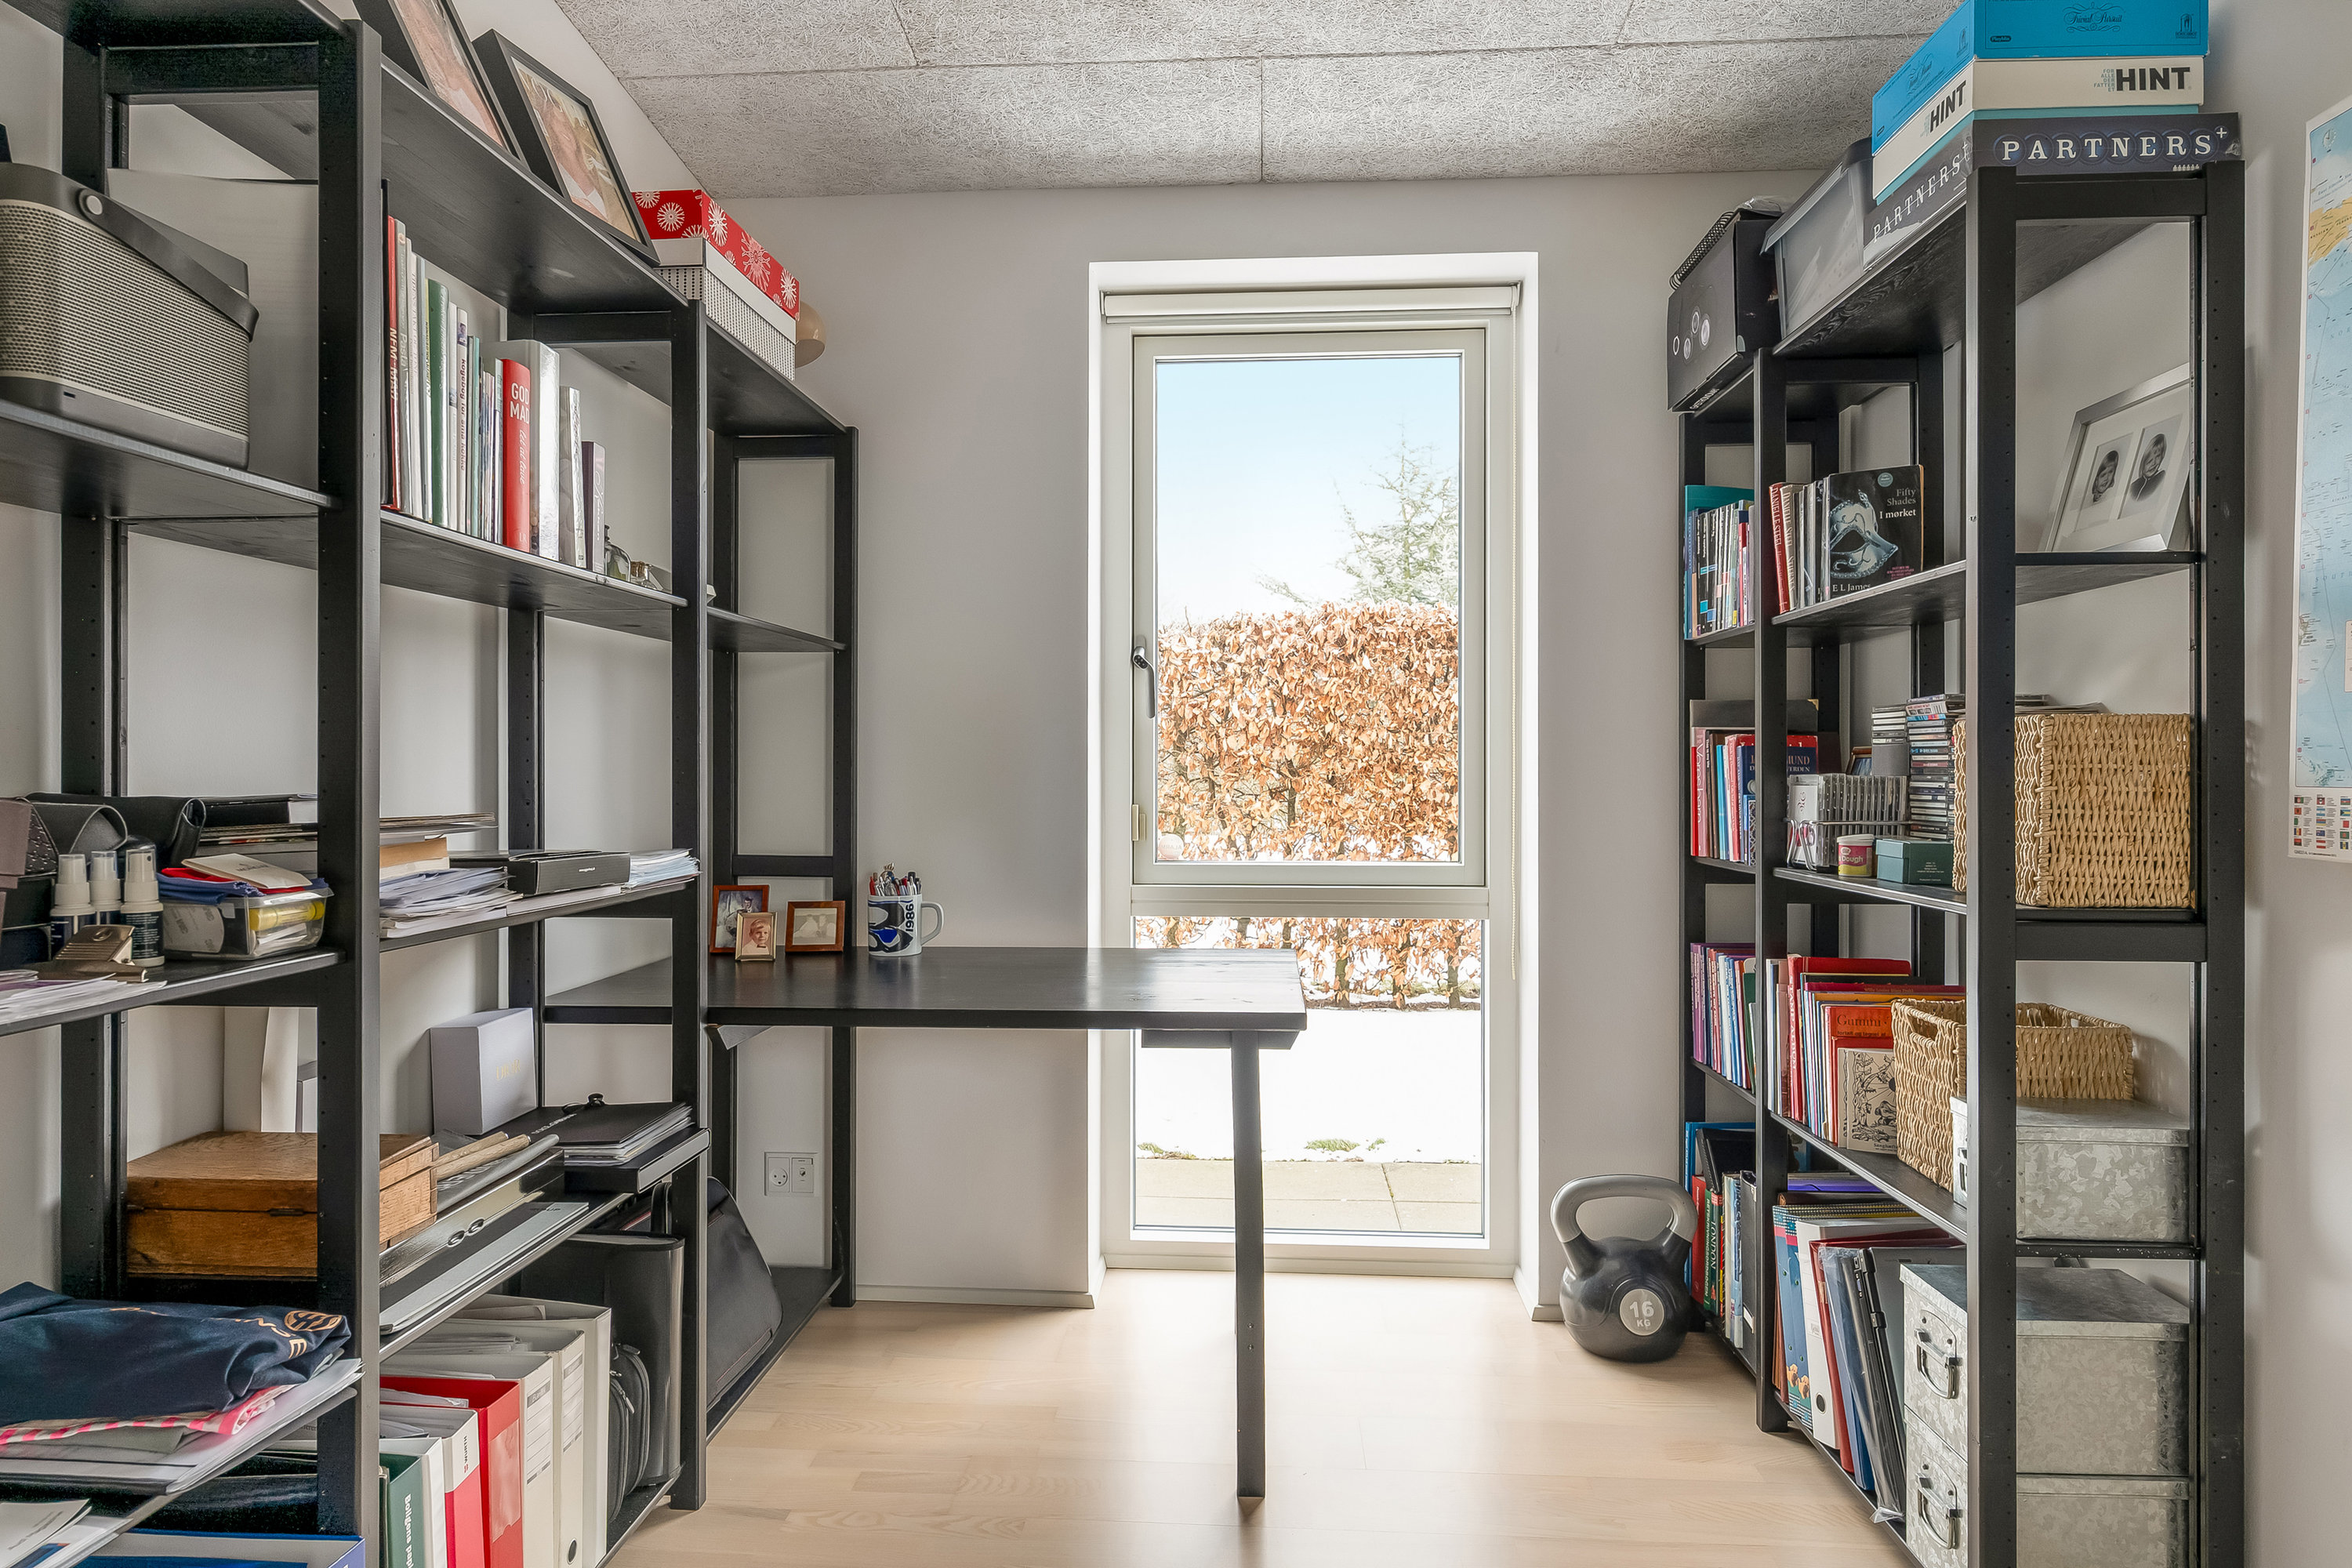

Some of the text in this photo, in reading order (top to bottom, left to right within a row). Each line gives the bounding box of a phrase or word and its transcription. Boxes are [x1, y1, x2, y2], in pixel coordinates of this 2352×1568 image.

[2116, 67, 2190, 91] HINT
[1930, 81, 1966, 133] HINT
[510, 383, 530, 405] GOD
[510, 401, 530, 424] MAD
[1887, 497, 1916, 506] Shades
[1896, 488, 1916, 498] Fifty
[1771, 487, 1780, 524] DANIELLE
[1886, 509, 1916, 519] mørket
[1773, 524, 1782, 546] STEEL
[1847, 583, 1871, 593] James
[904, 903, 915, 932] 1986
[1837, 1014, 1882, 1027] Gummi
[1629, 1301, 1654, 1319] 16
